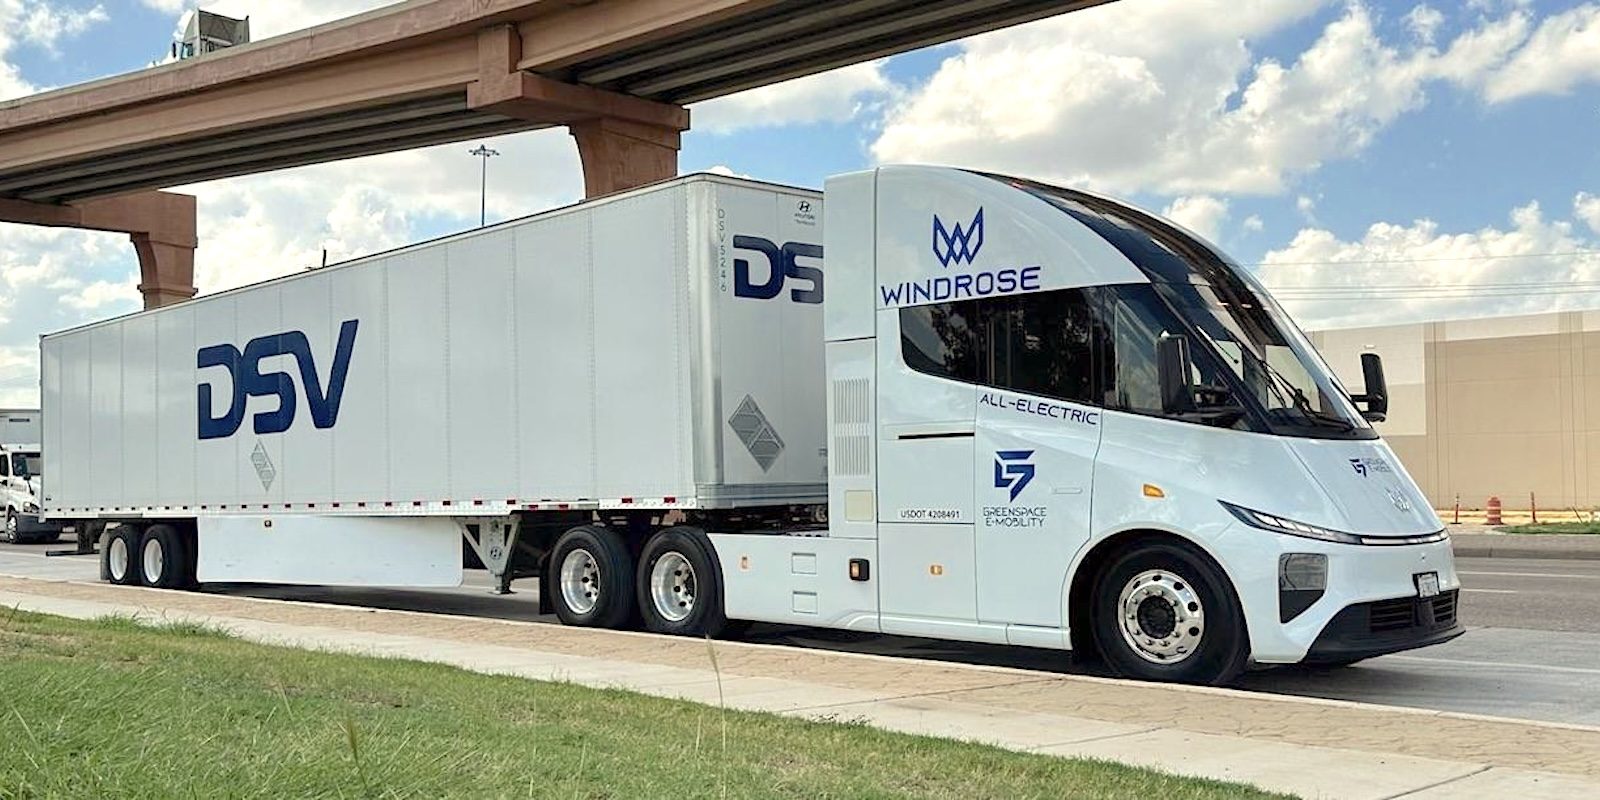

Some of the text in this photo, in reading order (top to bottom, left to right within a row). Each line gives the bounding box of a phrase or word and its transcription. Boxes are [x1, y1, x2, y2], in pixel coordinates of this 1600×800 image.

[733, 235, 824, 304] DS
[881, 266, 1041, 306] WINDROSE
[197, 319, 359, 440] DSV
[979, 394, 1099, 425] ALL-ELECTRIC
[900, 509, 926, 519] USDOT
[983, 506, 1047, 517] GREENSPACE
[985, 517, 1045, 527] E-MOBILITY
